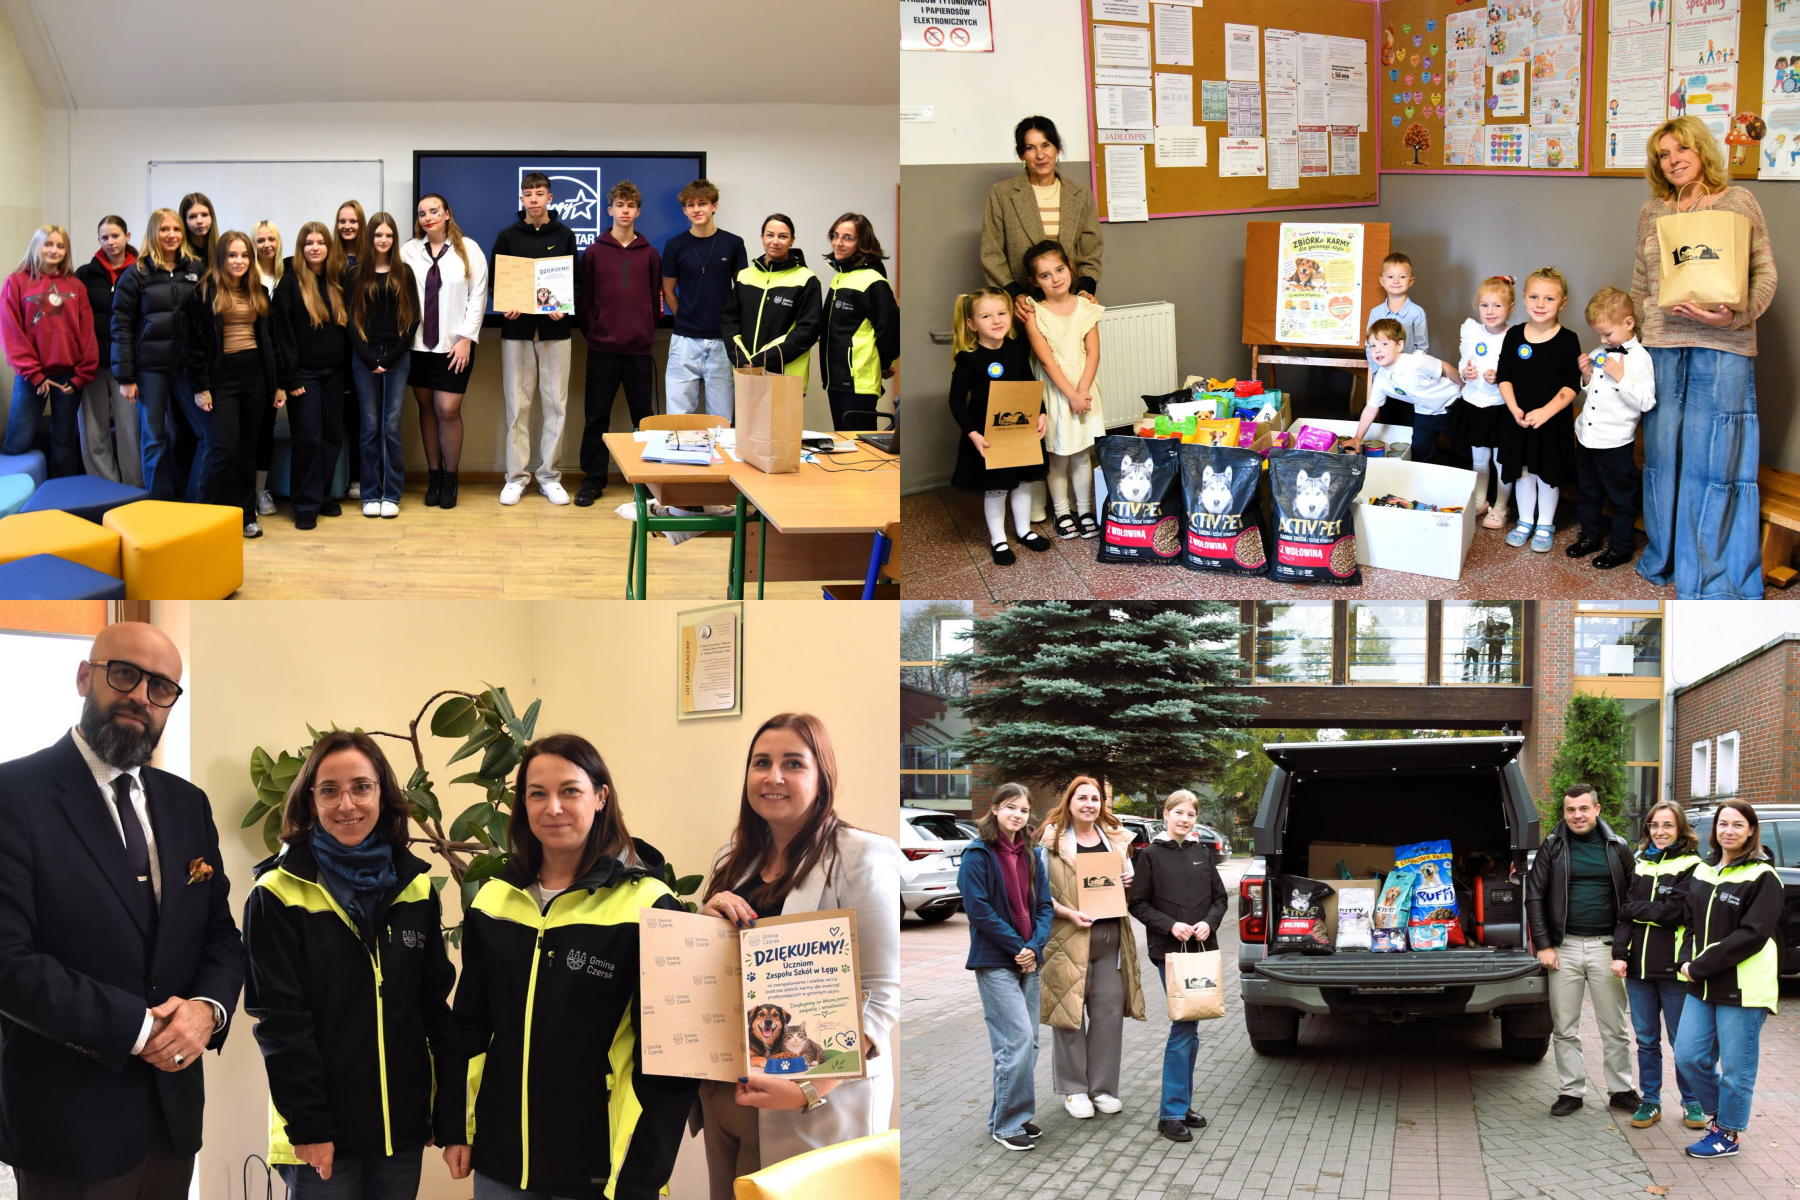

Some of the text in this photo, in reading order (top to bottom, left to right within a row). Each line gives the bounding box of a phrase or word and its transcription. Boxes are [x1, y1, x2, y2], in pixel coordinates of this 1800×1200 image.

[926, 7, 970, 15] PAPIEROSÓW
[914, 17, 977, 26] ELEKTRONICZNYCH
[1105, 132, 1146, 140] JADŁOSPIS
[575, 234, 595, 245] TAR
[1326, 237, 1350, 247] KARMY
[1107, 525, 1146, 539] Z WOŁOWINĄ
[1193, 538, 1227, 551] WOŁOWINĄ
[1285, 546, 1323, 559] WOŁOWINĄ
[1400, 856, 1431, 866] ECONOMY
[754, 939, 845, 967] DZIĘKUJEMY!
[590, 955, 615, 970] Gmina
[783, 960, 813, 969] Uczniom
[587, 965, 614, 980] Czersk
[766, 970, 792, 980] Zespołu
[794, 967, 812, 976] Szkół
[821, 966, 838, 974] Łęgu
[773, 980, 806, 989] zaangażowanie
